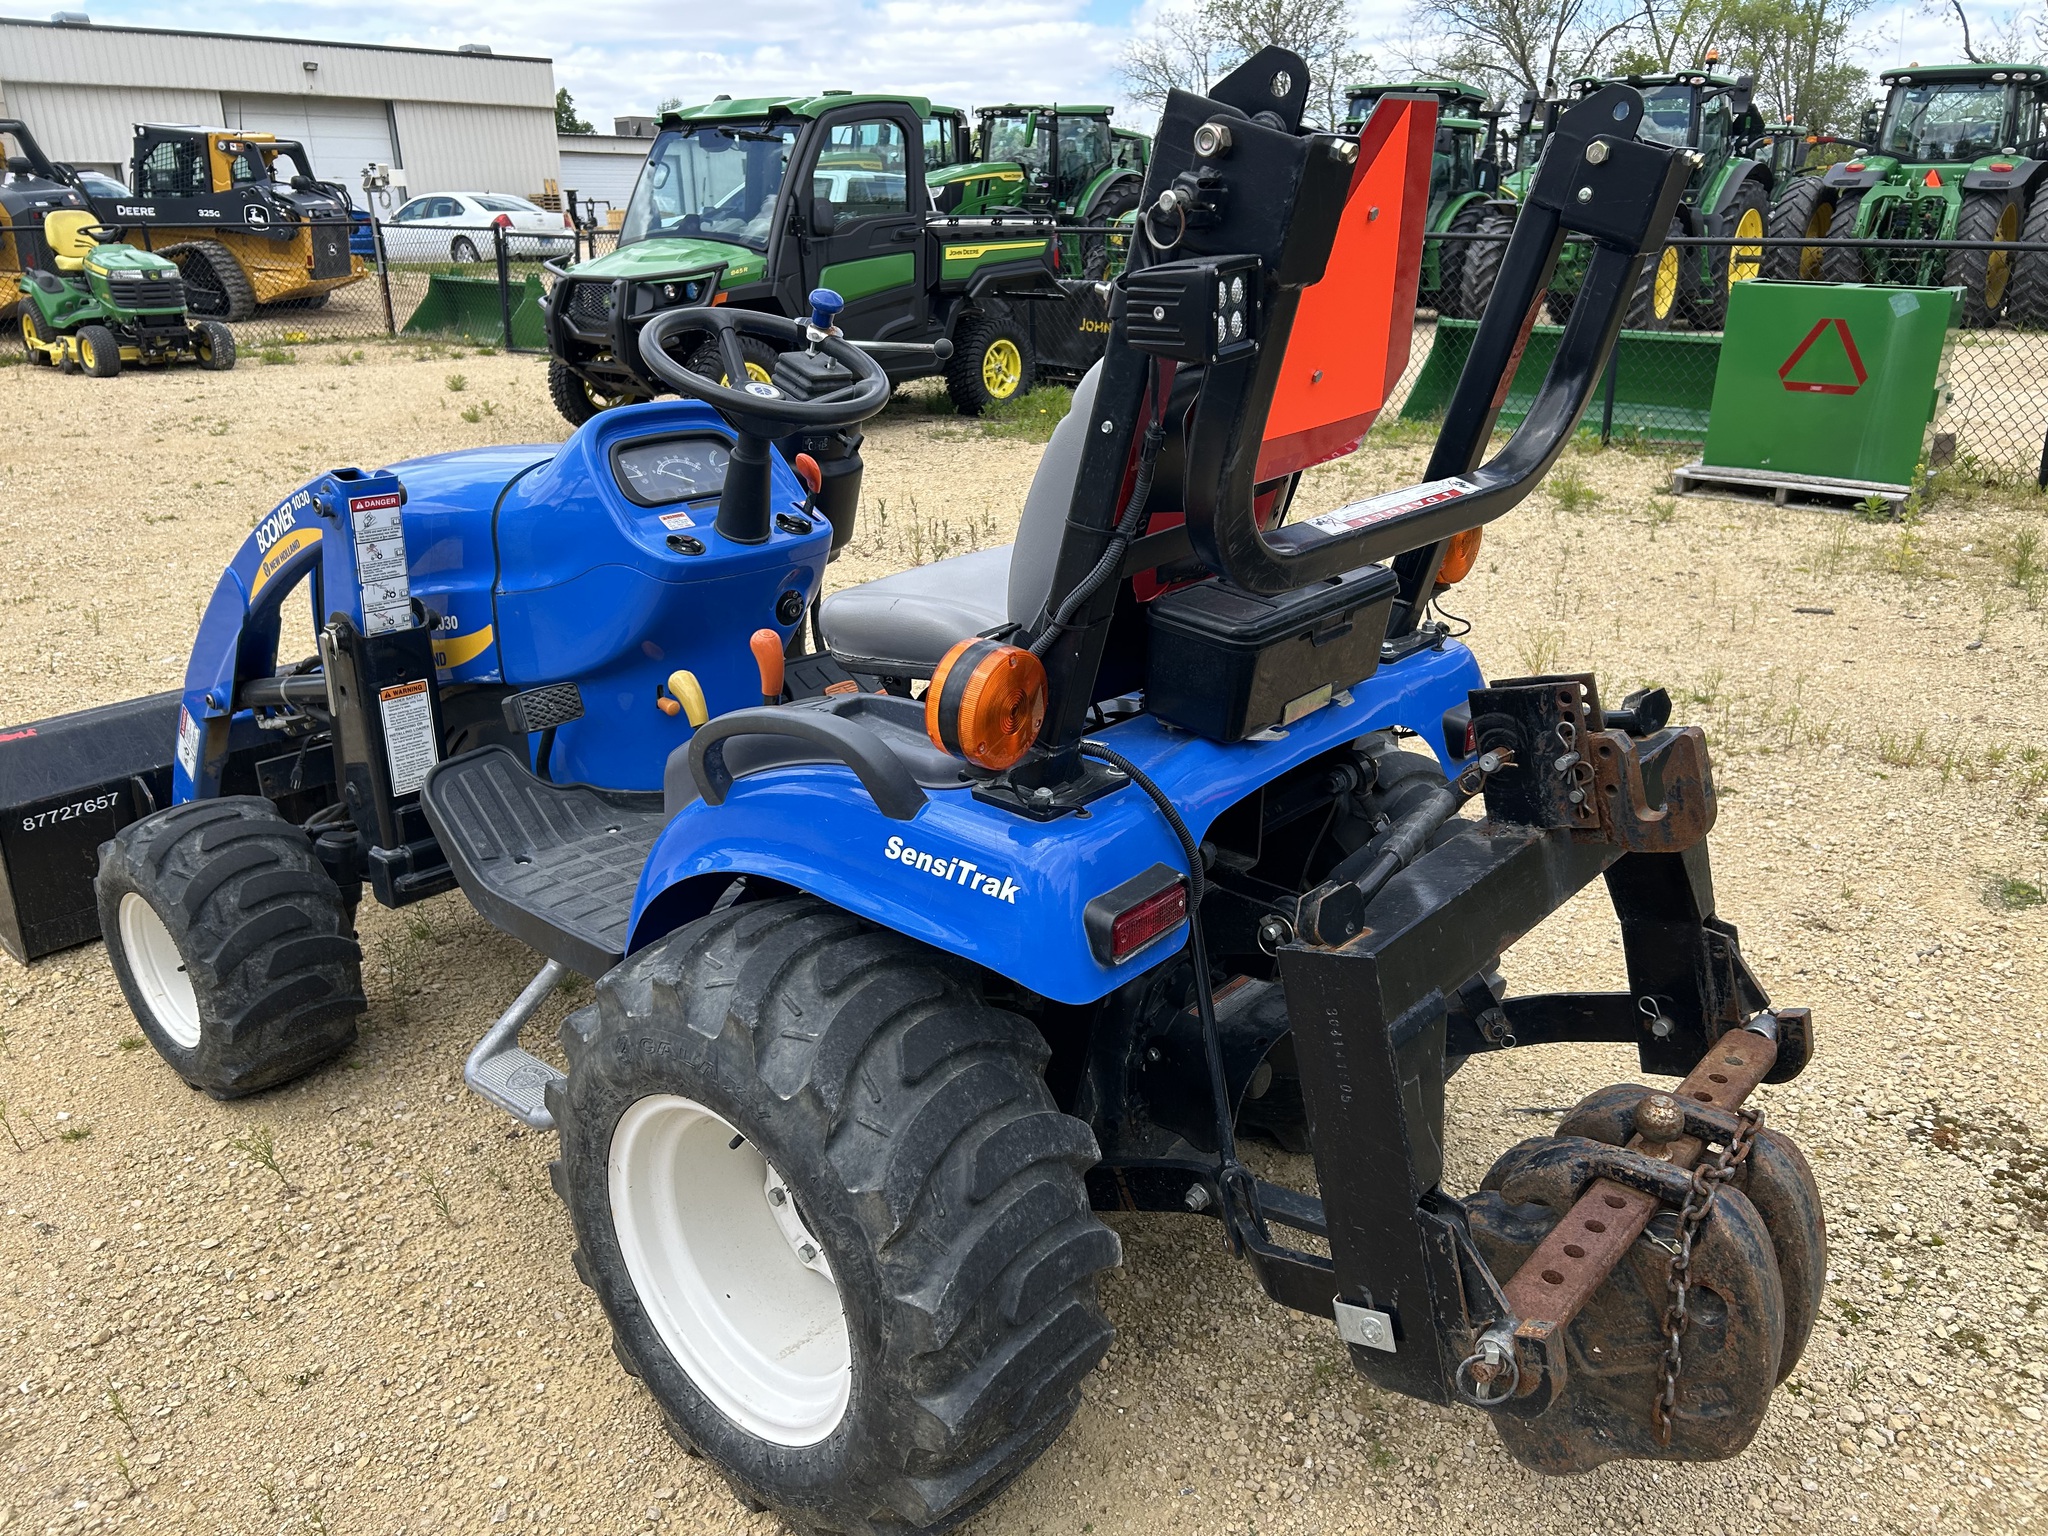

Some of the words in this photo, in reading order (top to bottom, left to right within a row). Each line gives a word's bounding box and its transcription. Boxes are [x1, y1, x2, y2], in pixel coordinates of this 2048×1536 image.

[116, 205, 155, 216] DEERE
[197, 209, 220, 217] 325G
[1079, 317, 1112, 333] JOHN
[364, 497, 396, 508] DANGER
[1358, 496, 1439, 524] DANGER
[255, 501, 296, 554] BOOMER
[291, 489, 310, 511] 1030
[269, 556, 281, 571] NEW
[278, 538, 301, 562] HOLLAND
[392, 684, 423, 696] WARNING
[22, 791, 119, 831] 87727657
[884, 836, 1021, 904] SensiTrak
